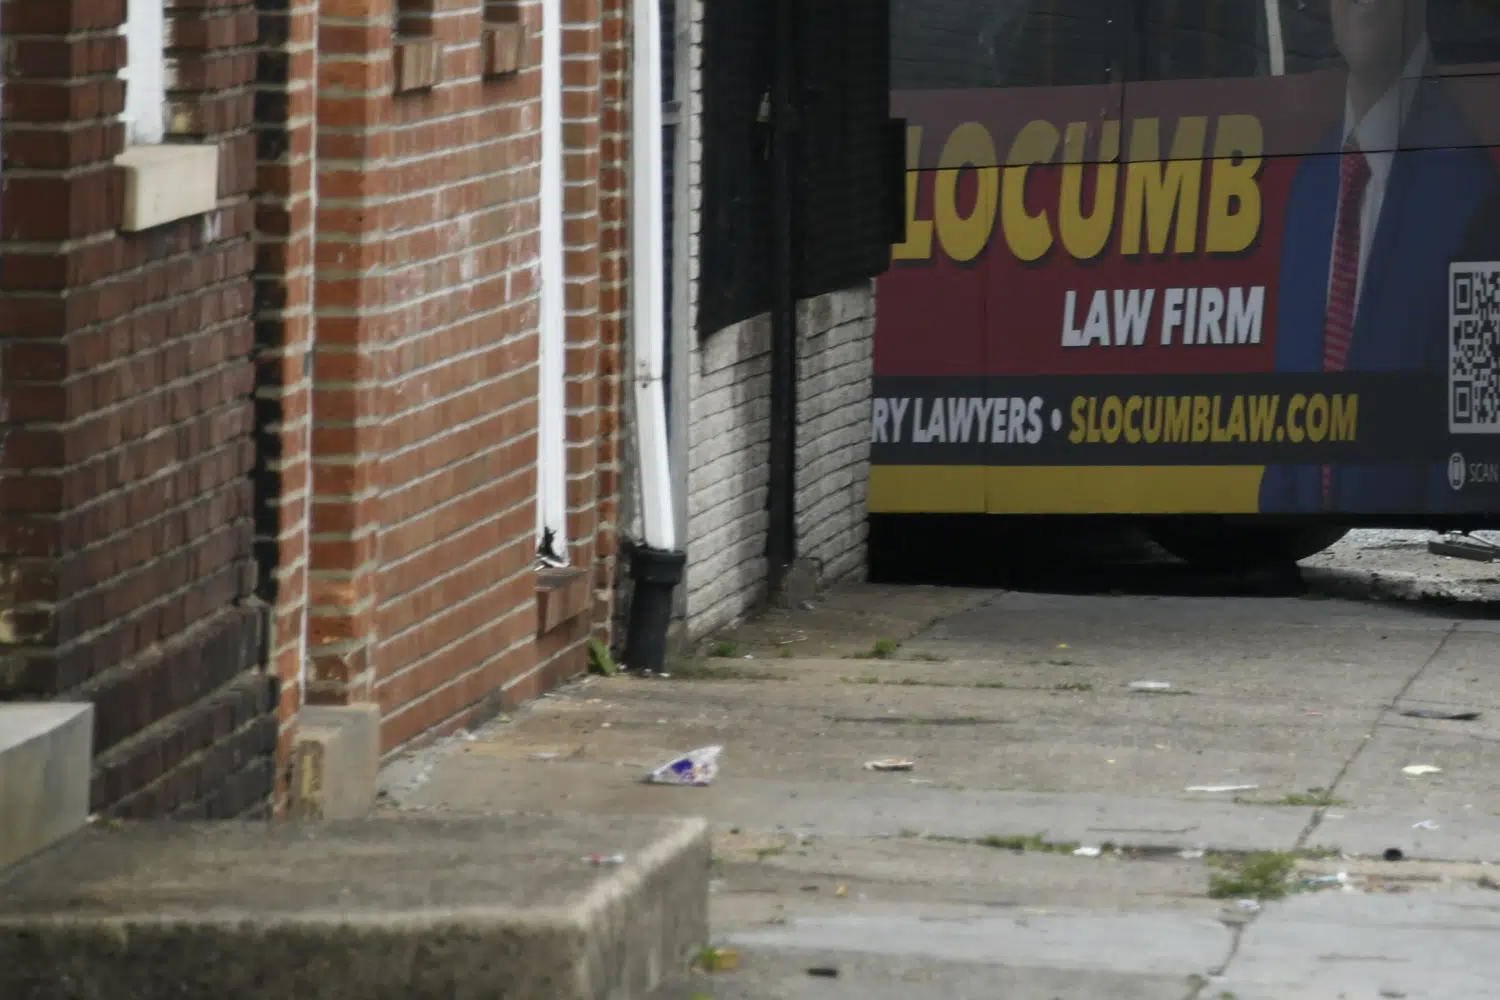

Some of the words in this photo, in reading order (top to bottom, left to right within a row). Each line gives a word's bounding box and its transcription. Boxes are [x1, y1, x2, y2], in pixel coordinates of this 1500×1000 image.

[1061, 288, 1156, 347] LAW
[1160, 286, 1266, 346] FIRM
[871, 397, 911, 443] RY
[912, 396, 1044, 444] LAWYERS
[1068, 393, 1358, 445] SLOCUMBLAW.COM
[1469, 462, 1499, 482] SCAN
